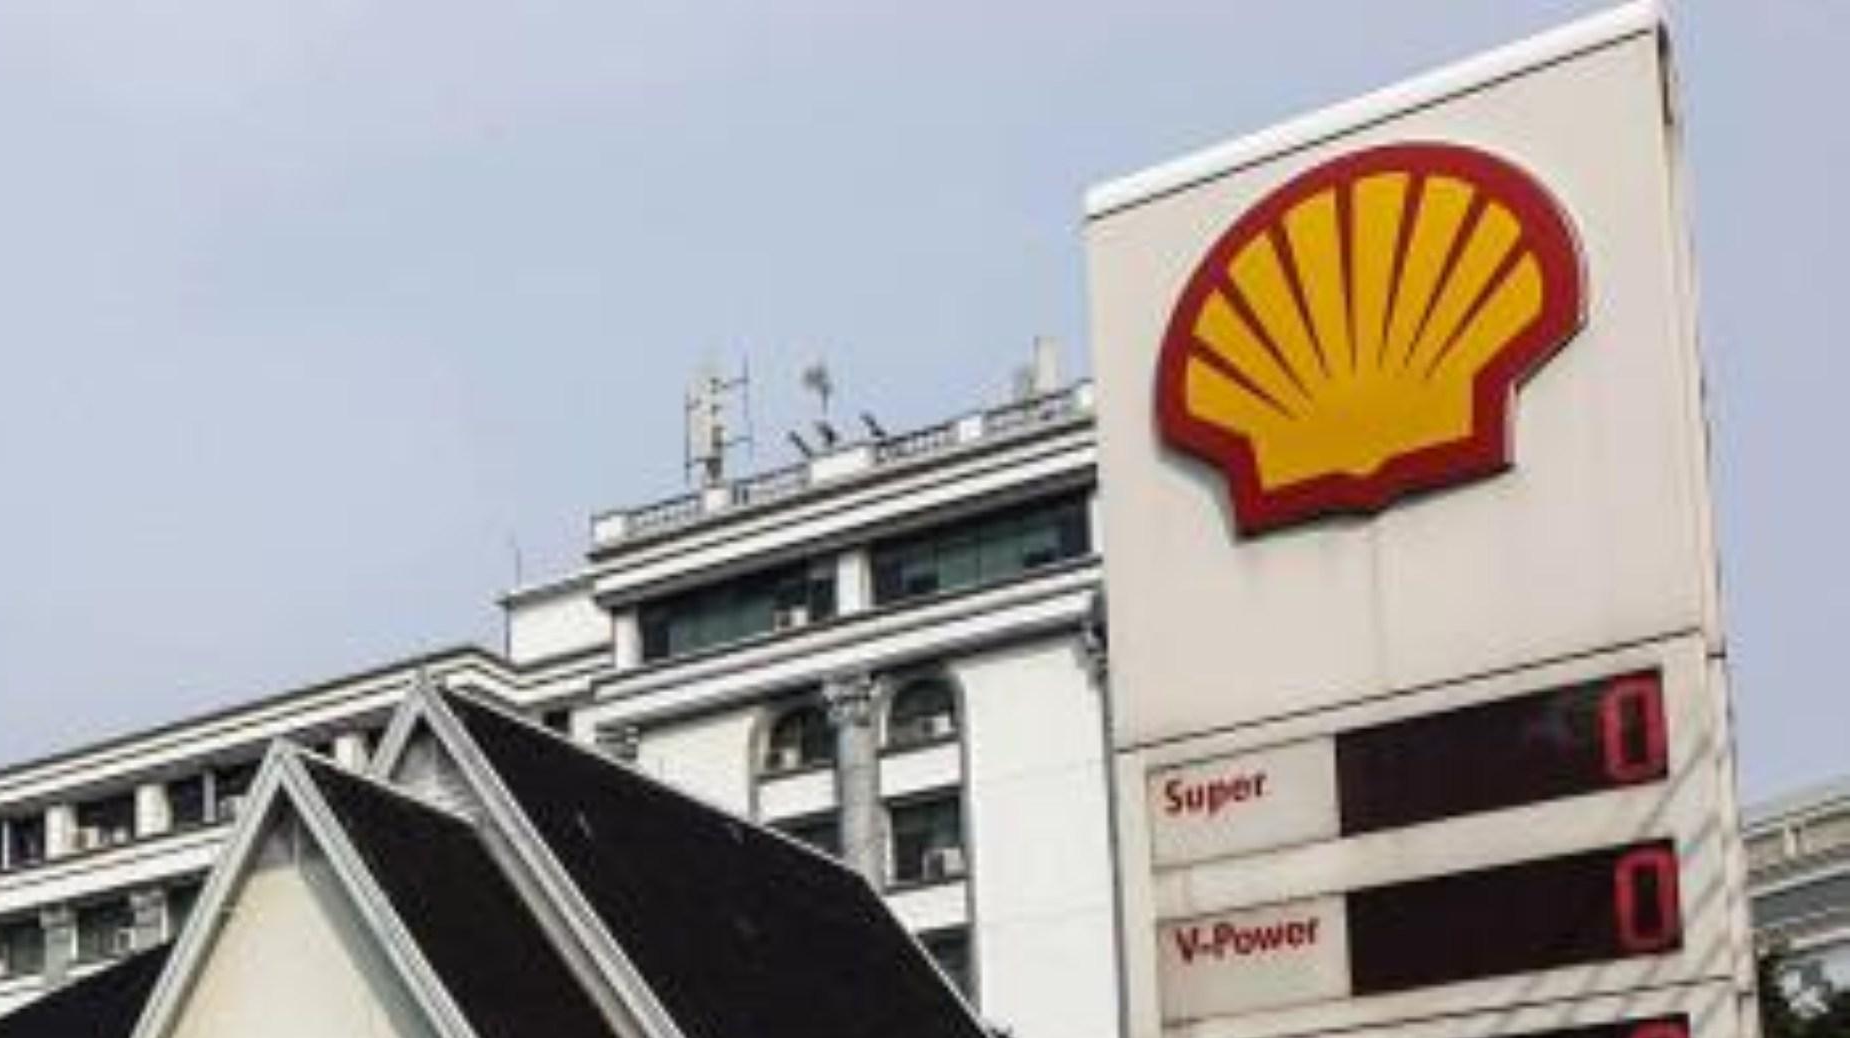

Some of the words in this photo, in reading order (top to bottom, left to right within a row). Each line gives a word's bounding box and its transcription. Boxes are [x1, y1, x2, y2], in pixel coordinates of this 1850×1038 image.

[1601, 675, 1667, 782] 0
[1164, 770, 1268, 816] Super
[1614, 847, 1680, 952] 0
[1176, 916, 1319, 964] V-Power
